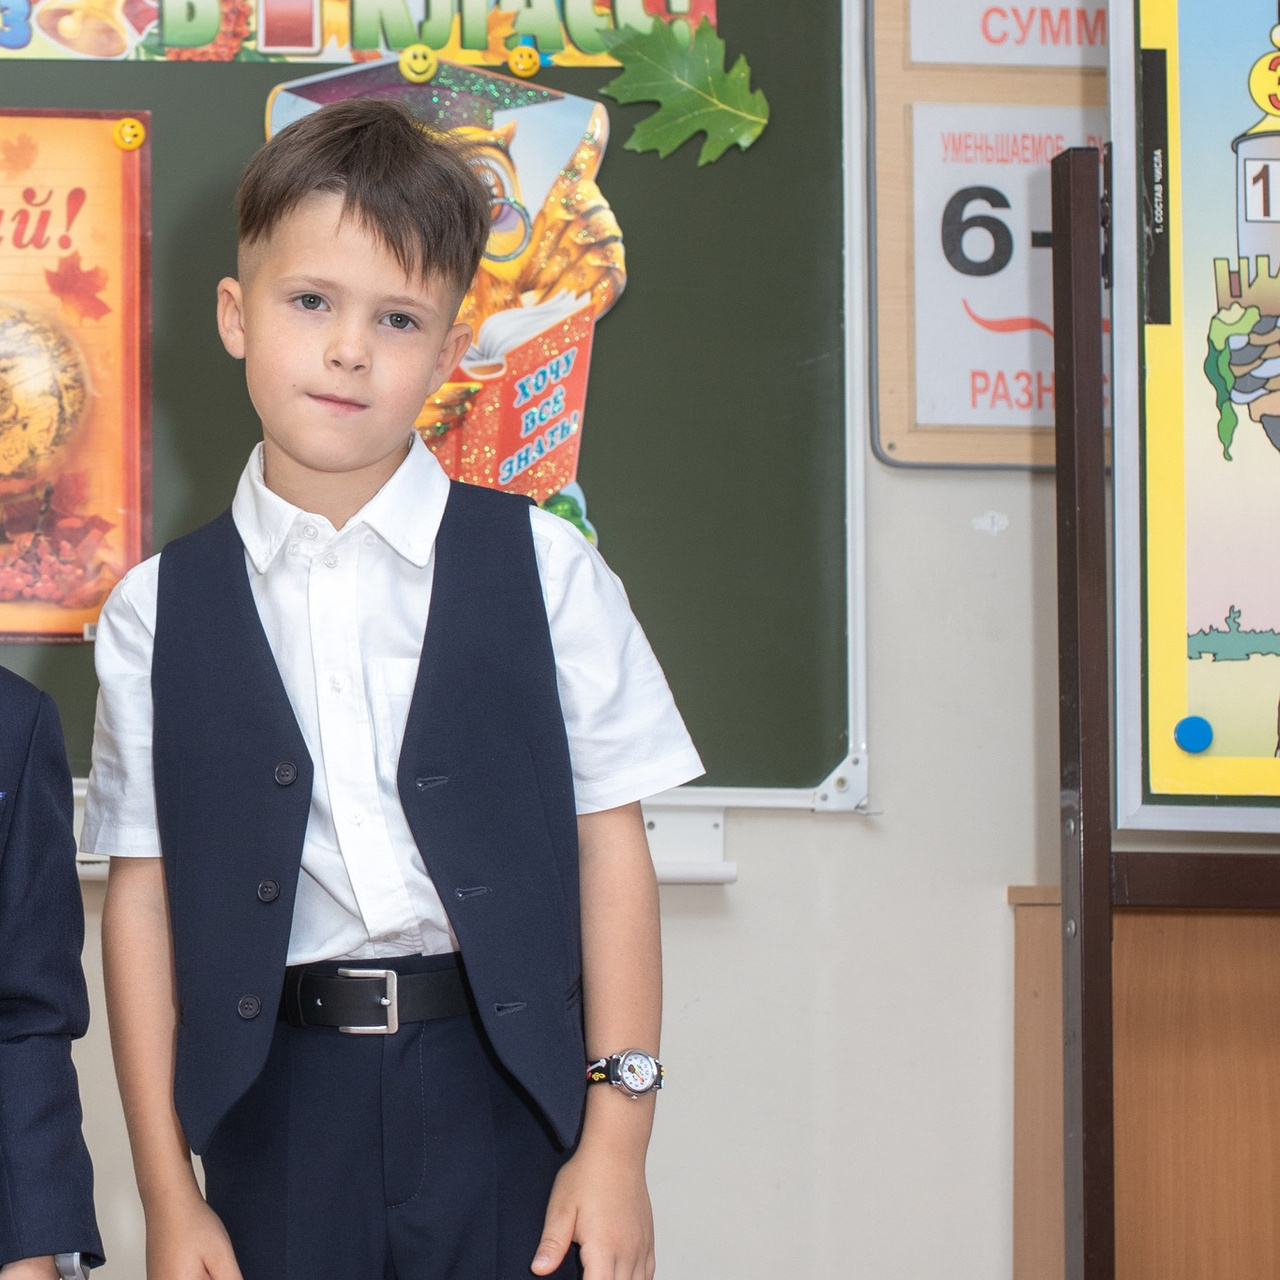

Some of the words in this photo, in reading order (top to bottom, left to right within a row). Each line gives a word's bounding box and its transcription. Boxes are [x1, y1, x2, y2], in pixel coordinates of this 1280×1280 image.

[1154, 183, 1163, 224] СОСТАВ
[1251, 164, 1270, 217] 1
[513, 346, 578, 408] ХОЧУ
[499, 409, 579, 486] ЗНАТЬ!
